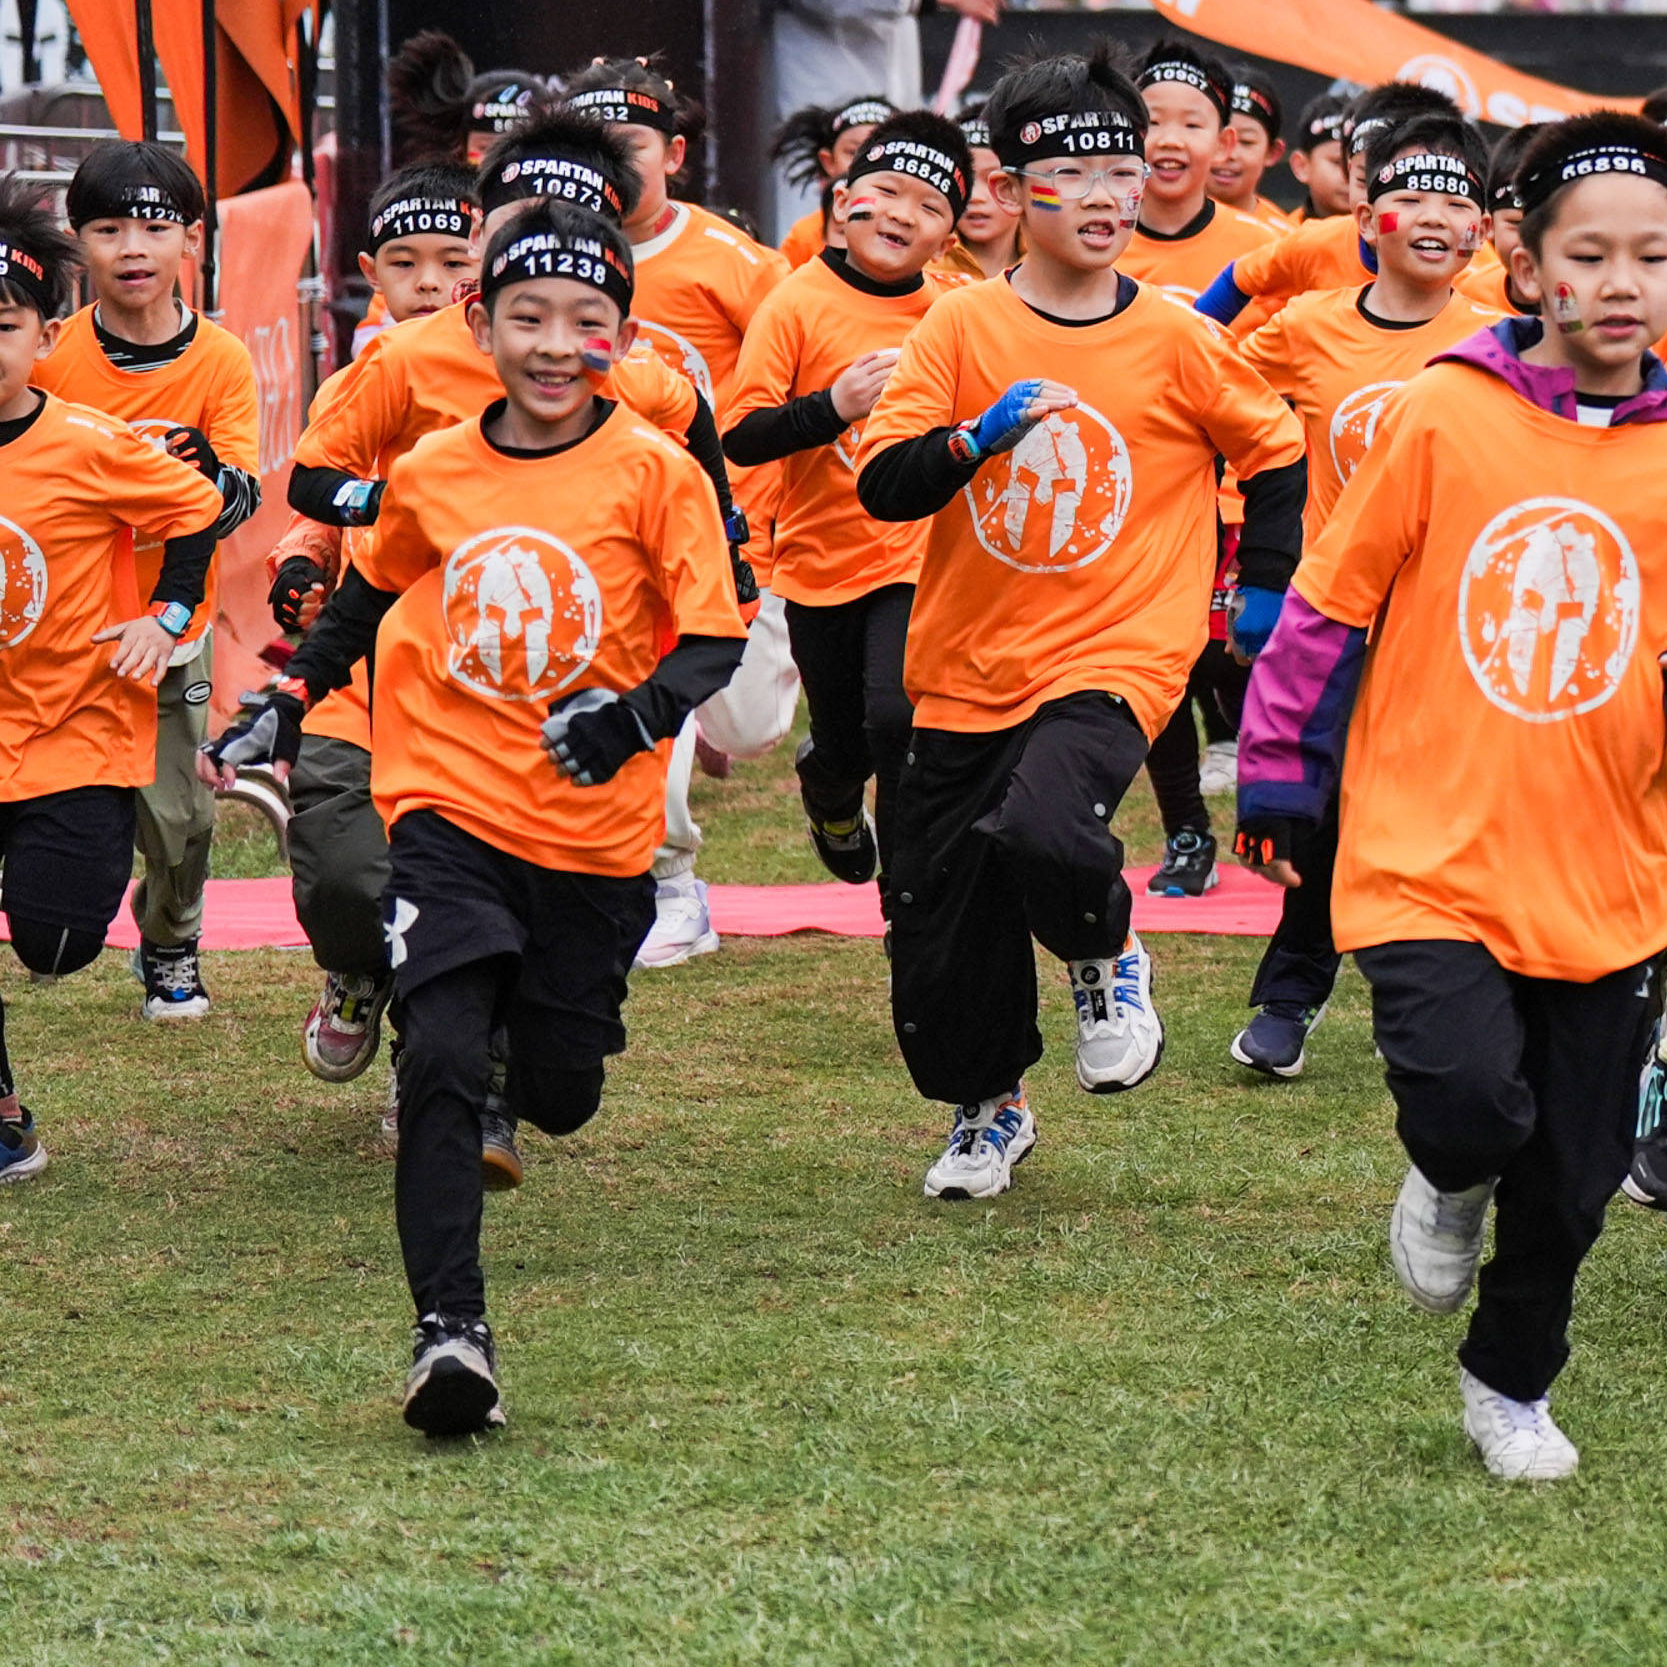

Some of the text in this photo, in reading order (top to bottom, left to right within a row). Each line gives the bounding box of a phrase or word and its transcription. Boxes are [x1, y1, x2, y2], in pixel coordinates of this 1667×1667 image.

[627, 91, 660, 114] KIDS
[884, 140, 955, 173] SPARTAN
[1062, 132, 1136, 153] 10811
[521, 159, 604, 191] SPARTAN
[892, 157, 953, 195] 86846
[1395, 153, 1467, 177] SPARTAN
[532, 177, 603, 213] 10873
[1405, 174, 1470, 198] 85680
[382, 198, 458, 225] SPARTAN
[393, 213, 463, 236] 11069
[11, 248, 44, 282] KIDS
[524, 253, 607, 285] 11238
